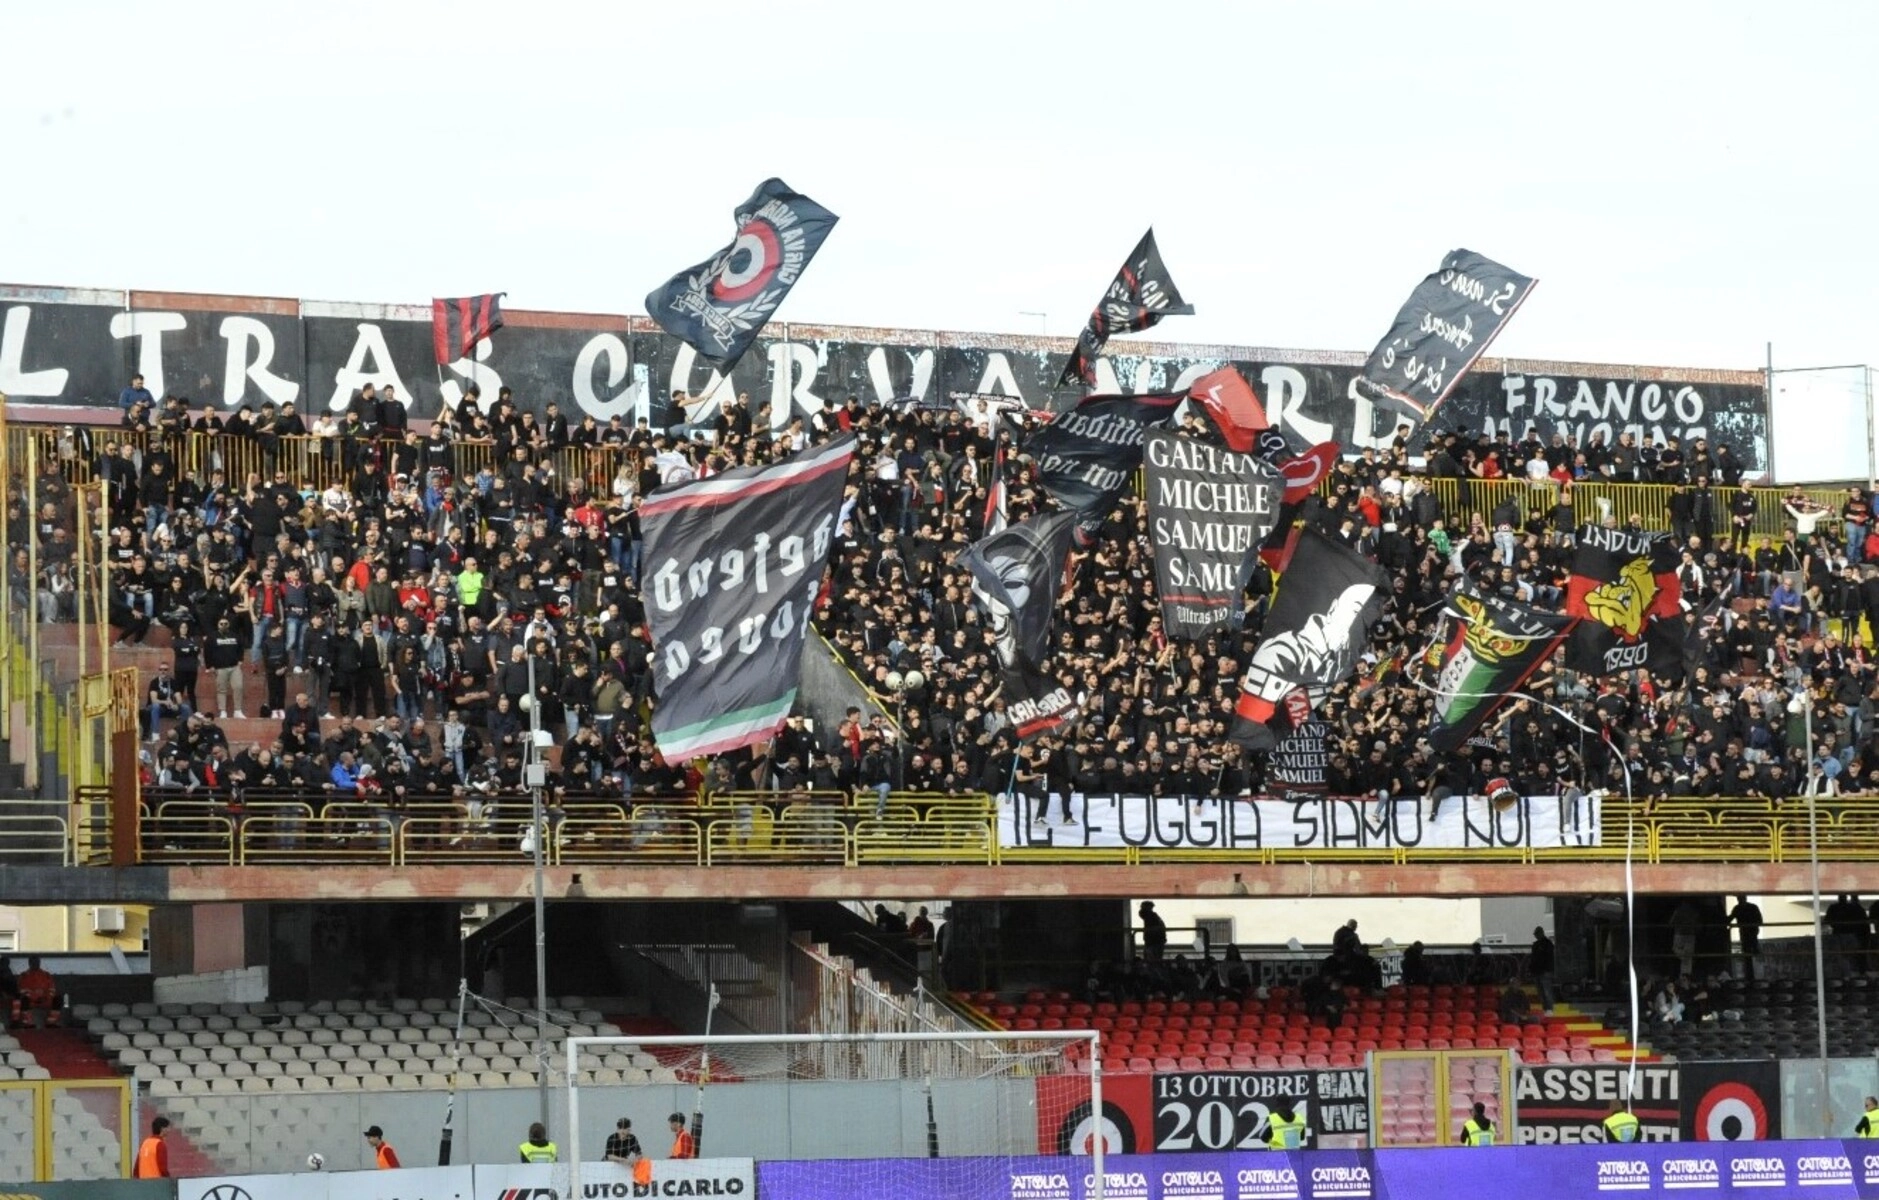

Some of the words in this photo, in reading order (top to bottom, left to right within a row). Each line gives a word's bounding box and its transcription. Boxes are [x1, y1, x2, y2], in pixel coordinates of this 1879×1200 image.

[1501, 374, 1704, 424] FRANCO
[1158, 477, 1270, 514] MICHELE
[1176, 606, 1211, 624] Ultras
[1603, 642, 1648, 673] 1990
[1274, 767, 1327, 783] SAMUEL
[1293, 798, 1422, 848] SIAMO
[1463, 796, 1531, 848] NOI
[1158, 1076, 1182, 1098] 13
[1189, 1073, 1310, 1098] OTTOBRE
[1516, 1068, 1679, 1101] ASSENTI
[1662, 1159, 1718, 1174] CATTOLICA
[1731, 1158, 1786, 1172] CATTOLICA
[1797, 1156, 1852, 1171] CATTOLICA
[1162, 1171, 1223, 1187] CATTOLICA
[1238, 1169, 1298, 1185] CATTOLICA
[1311, 1167, 1371, 1183] CATTOLICA
[567, 1182, 629, 1199] UTO
[662, 1177, 744, 1198] CARLO
